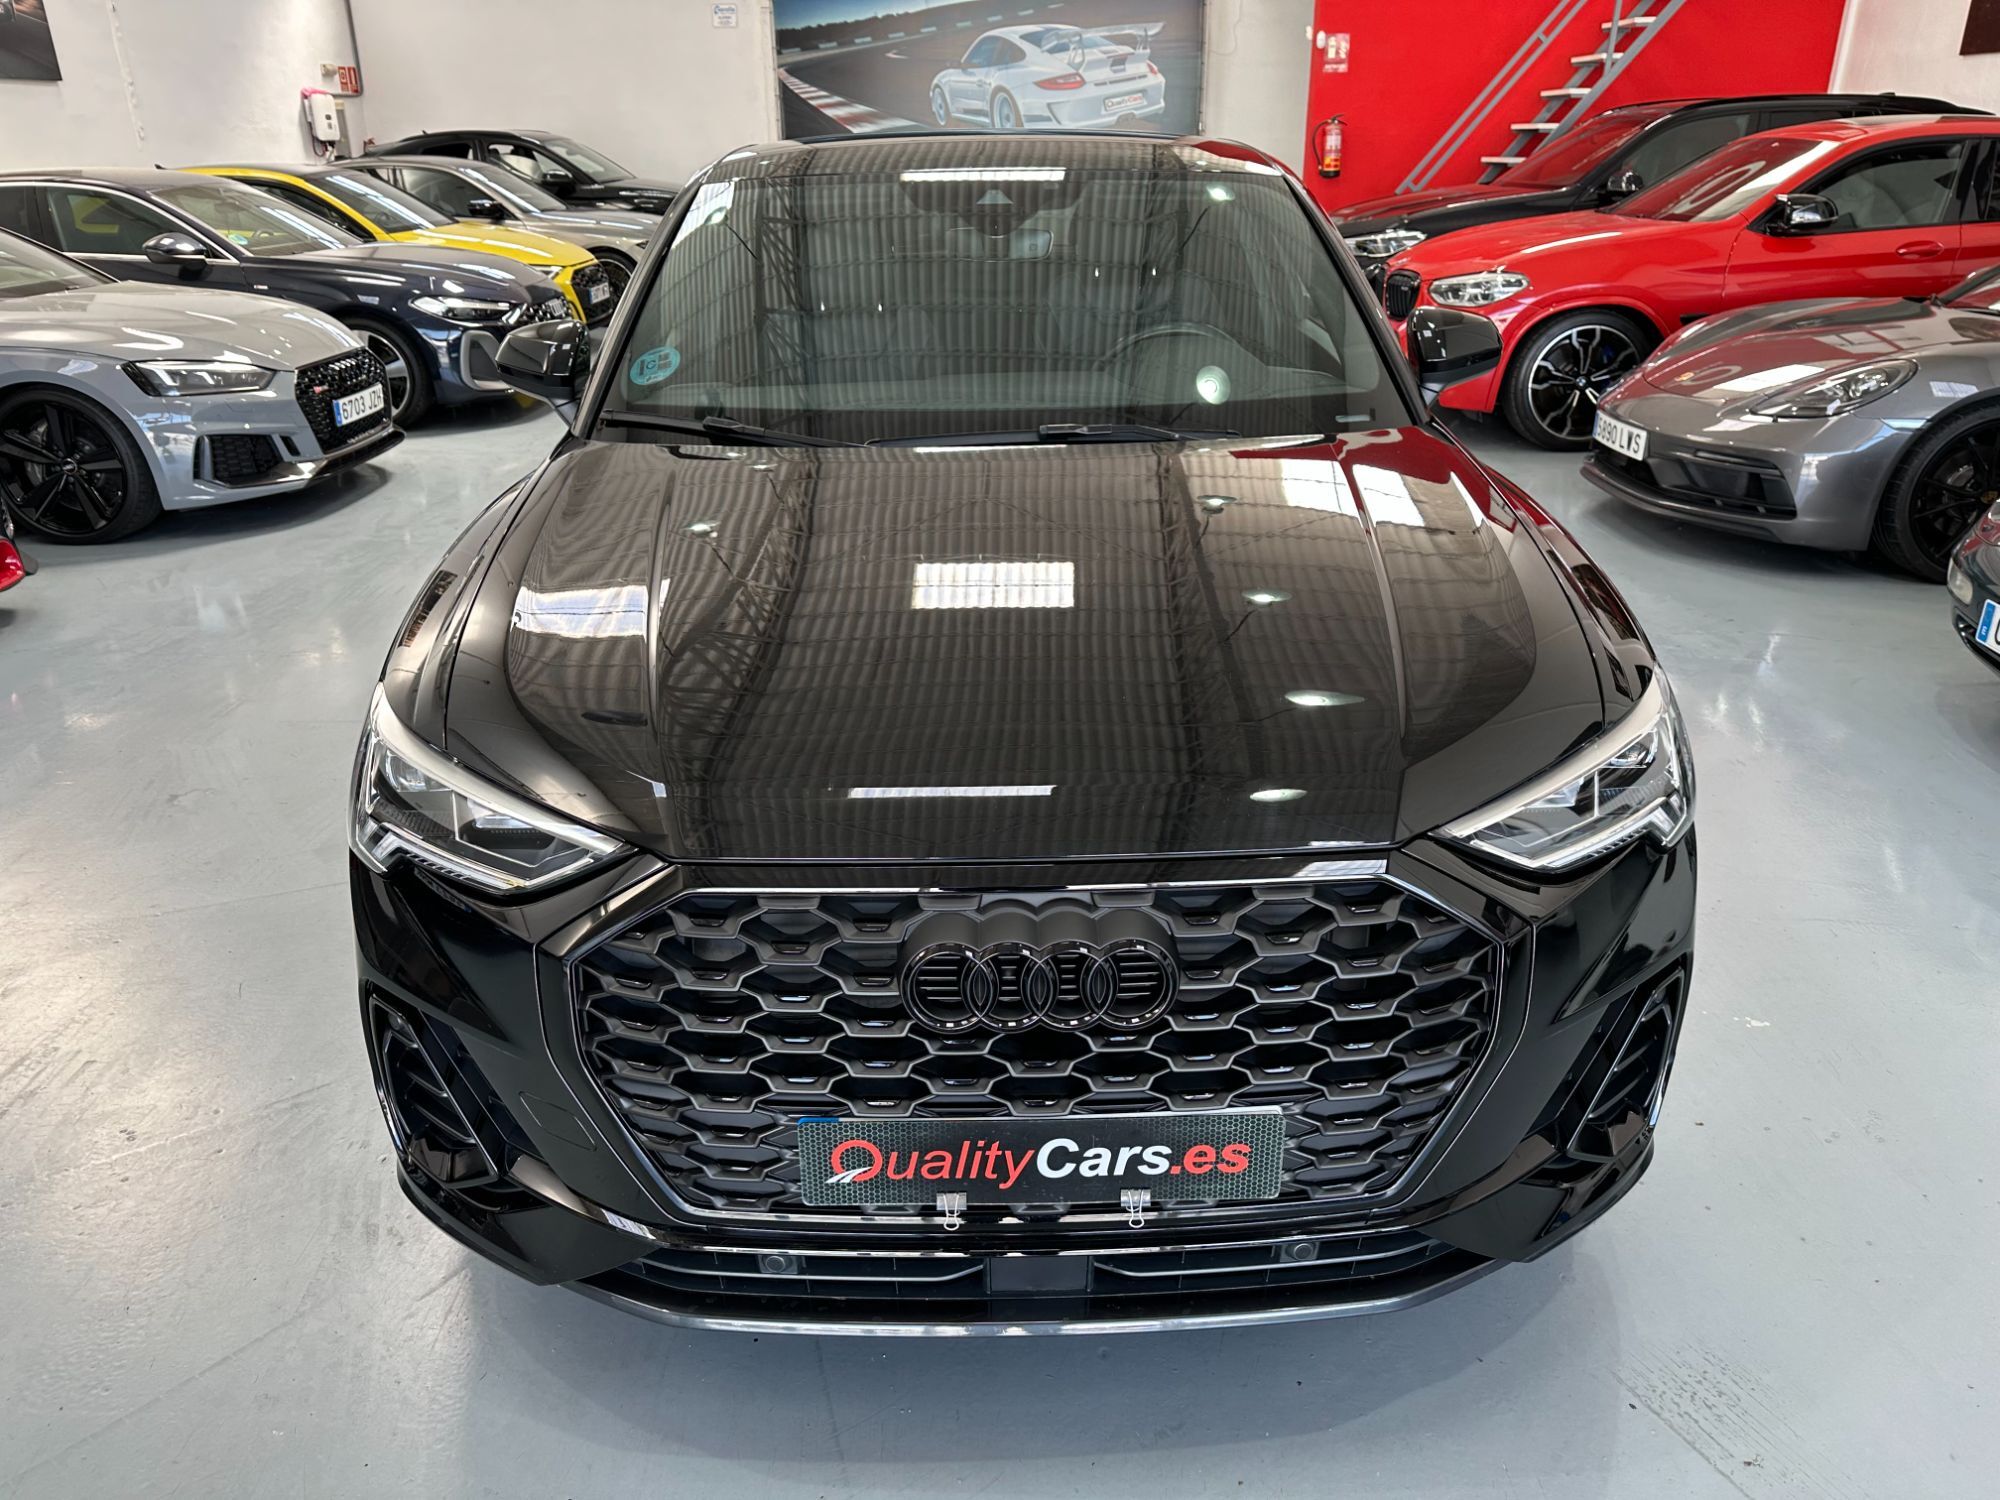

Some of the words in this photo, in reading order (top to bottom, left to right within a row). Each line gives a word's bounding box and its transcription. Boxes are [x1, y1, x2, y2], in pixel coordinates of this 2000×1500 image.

[342, 396, 366, 420] 6703
[368, 388, 382, 410] JZH
[826, 1138, 1253, 1190] QualityCars.es
